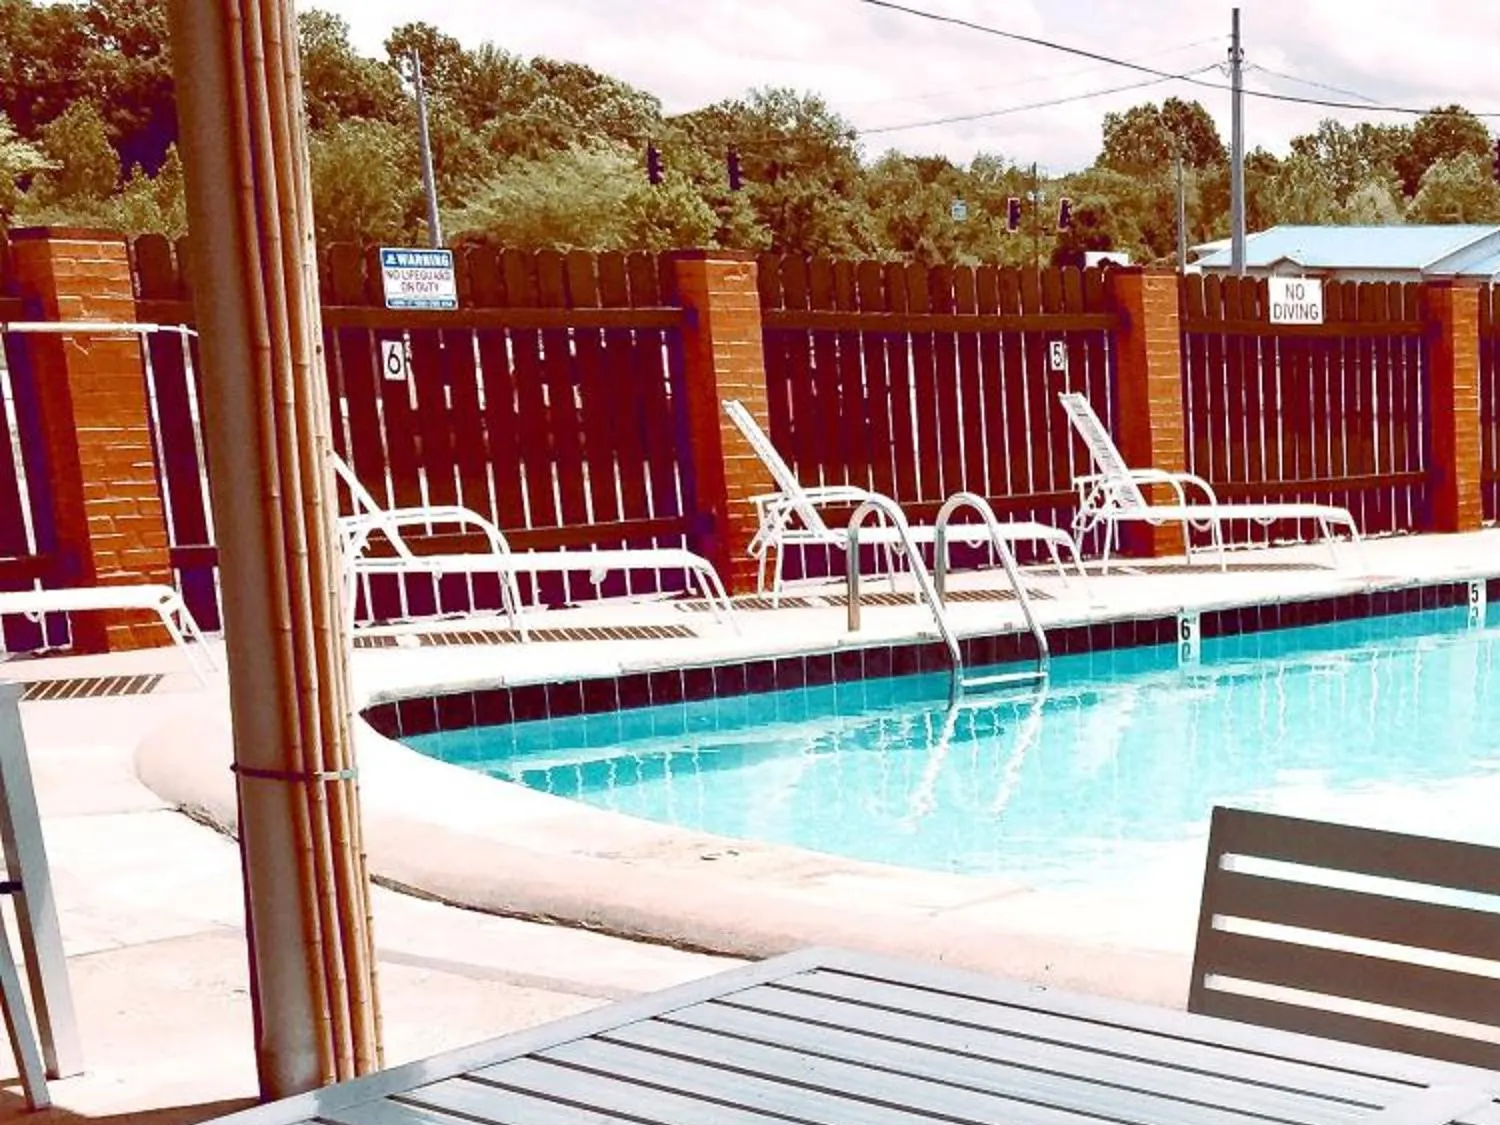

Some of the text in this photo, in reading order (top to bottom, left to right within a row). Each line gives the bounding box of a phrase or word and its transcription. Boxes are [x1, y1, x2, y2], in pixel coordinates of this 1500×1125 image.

[396, 253, 449, 267] WARNING
[387, 269, 451, 281] NO LIFEGUARD
[401, 281, 439, 293] ON DUTY
[1285, 283, 1305, 300] NO
[1273, 303, 1319, 320] DIVING
[387, 344, 401, 374] 6
[1471, 583, 1479, 603] 5
[1181, 617, 1191, 641] 6
